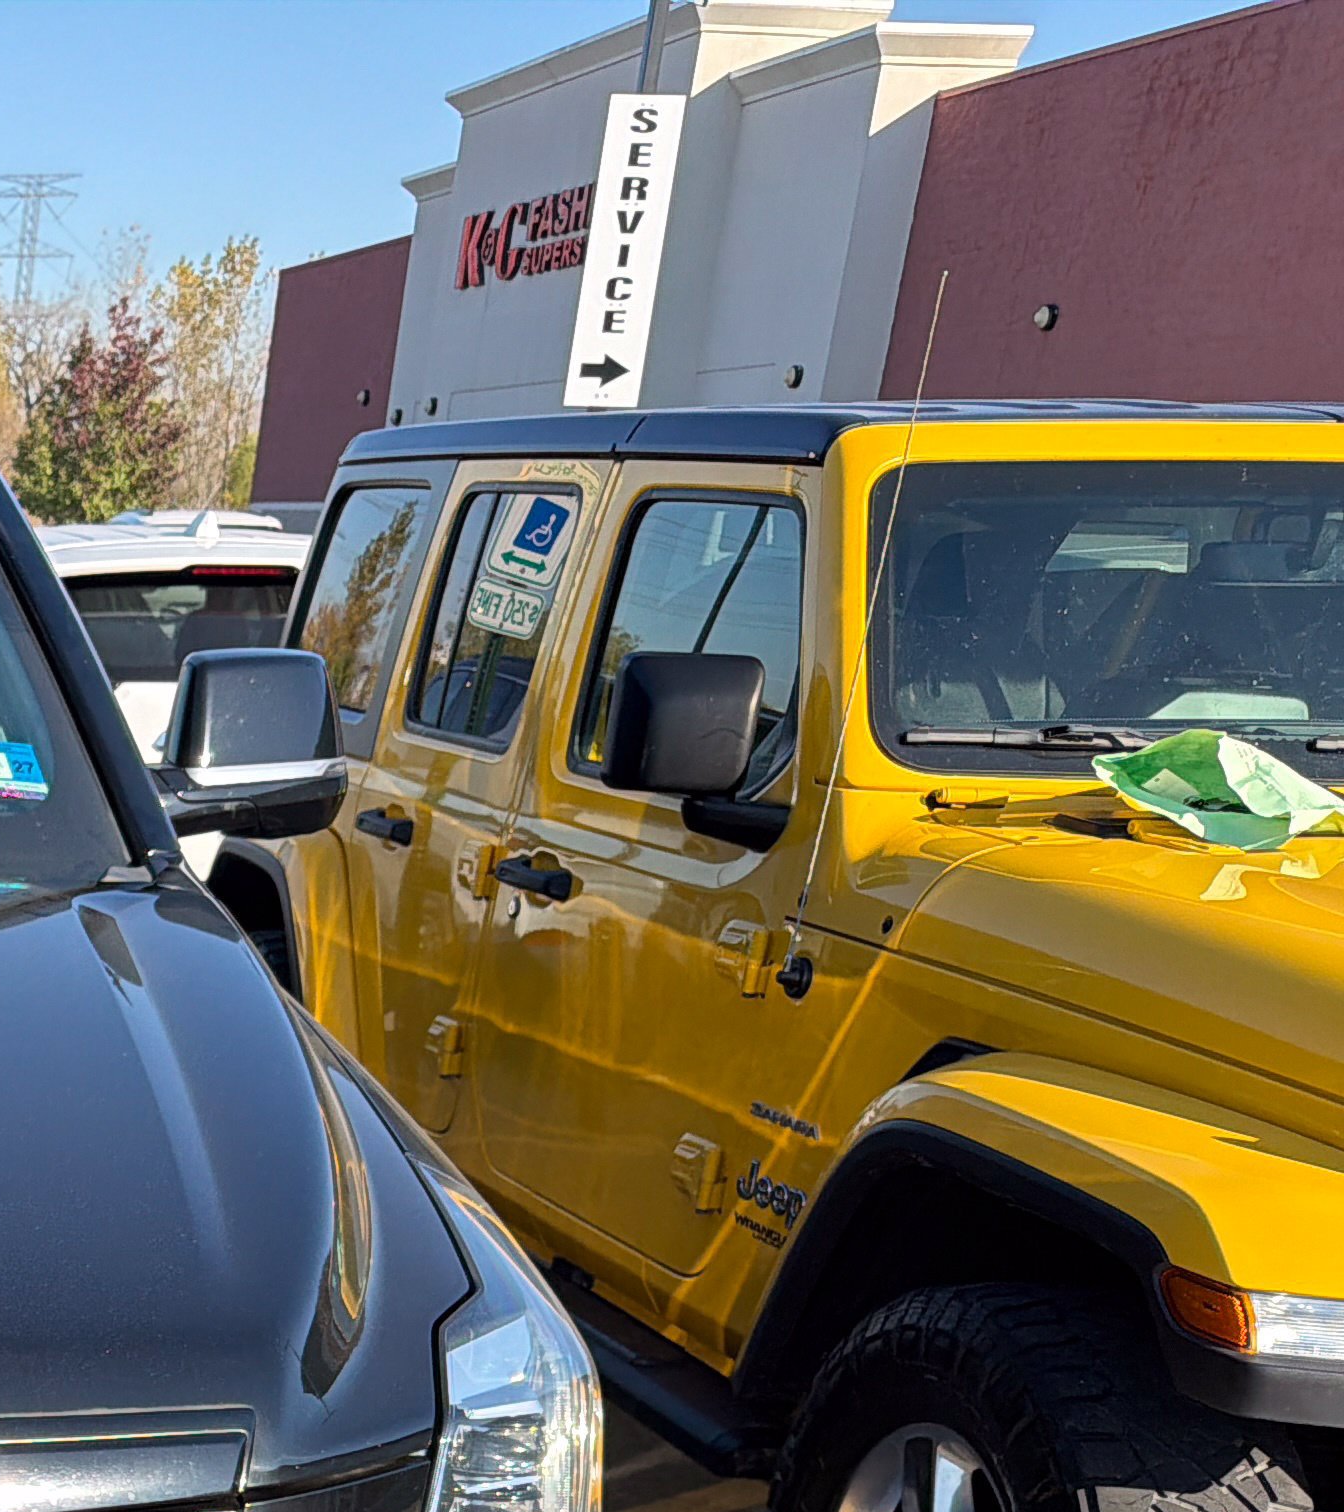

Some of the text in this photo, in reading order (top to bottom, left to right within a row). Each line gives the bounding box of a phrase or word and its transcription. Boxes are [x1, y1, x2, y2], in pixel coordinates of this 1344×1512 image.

[526, 181, 596, 242] FASH
[601, 108, 659, 334] SERVICE
[455, 202, 528, 290] K&G
[520, 235, 588, 276] SUPERS
[12, 759, 35, 775] 27
[736, 1159, 808, 1231] Jeep
